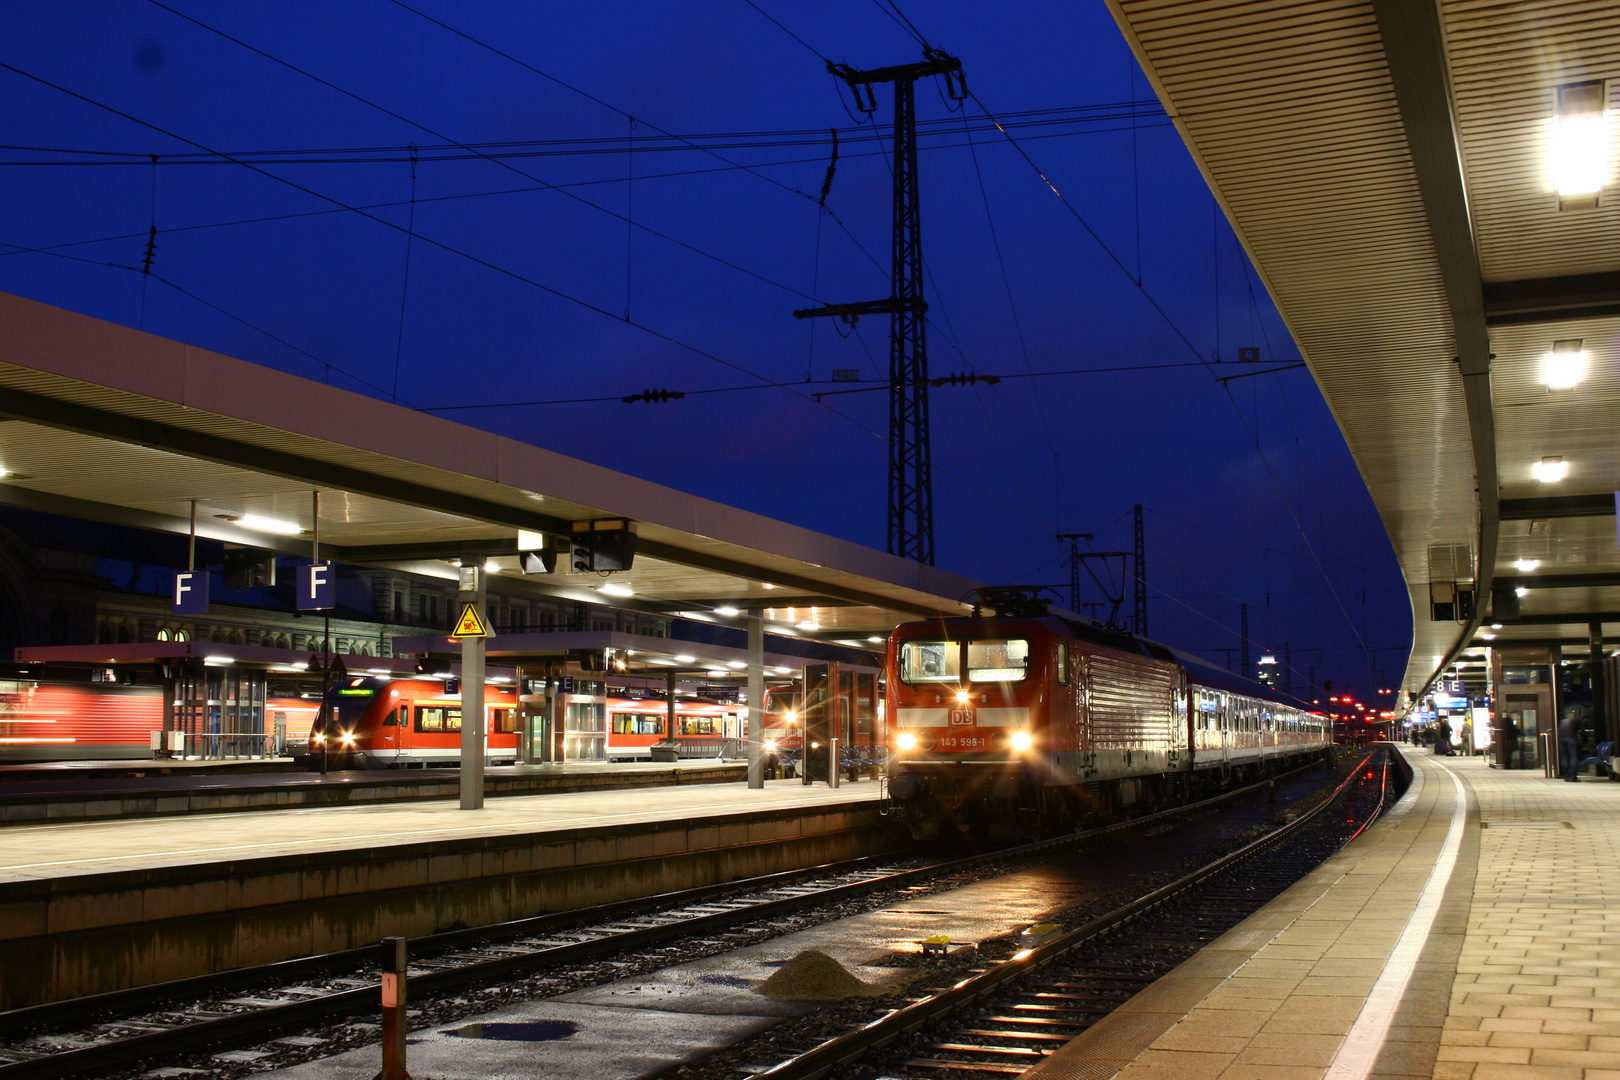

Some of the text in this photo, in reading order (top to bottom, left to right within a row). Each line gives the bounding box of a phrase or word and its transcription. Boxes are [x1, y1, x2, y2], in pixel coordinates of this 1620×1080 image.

[310, 566, 328, 599] F
[176, 573, 193, 605] F
[17, 650, 23, 659] 2
[186, 644, 192, 653] 3
[446, 679, 453, 691] E
[564, 677, 571, 689] E
[1436, 681, 1460, 692] 8 E
[952, 710, 973, 725] DB
[941, 737, 985, 747] 143 598-1
